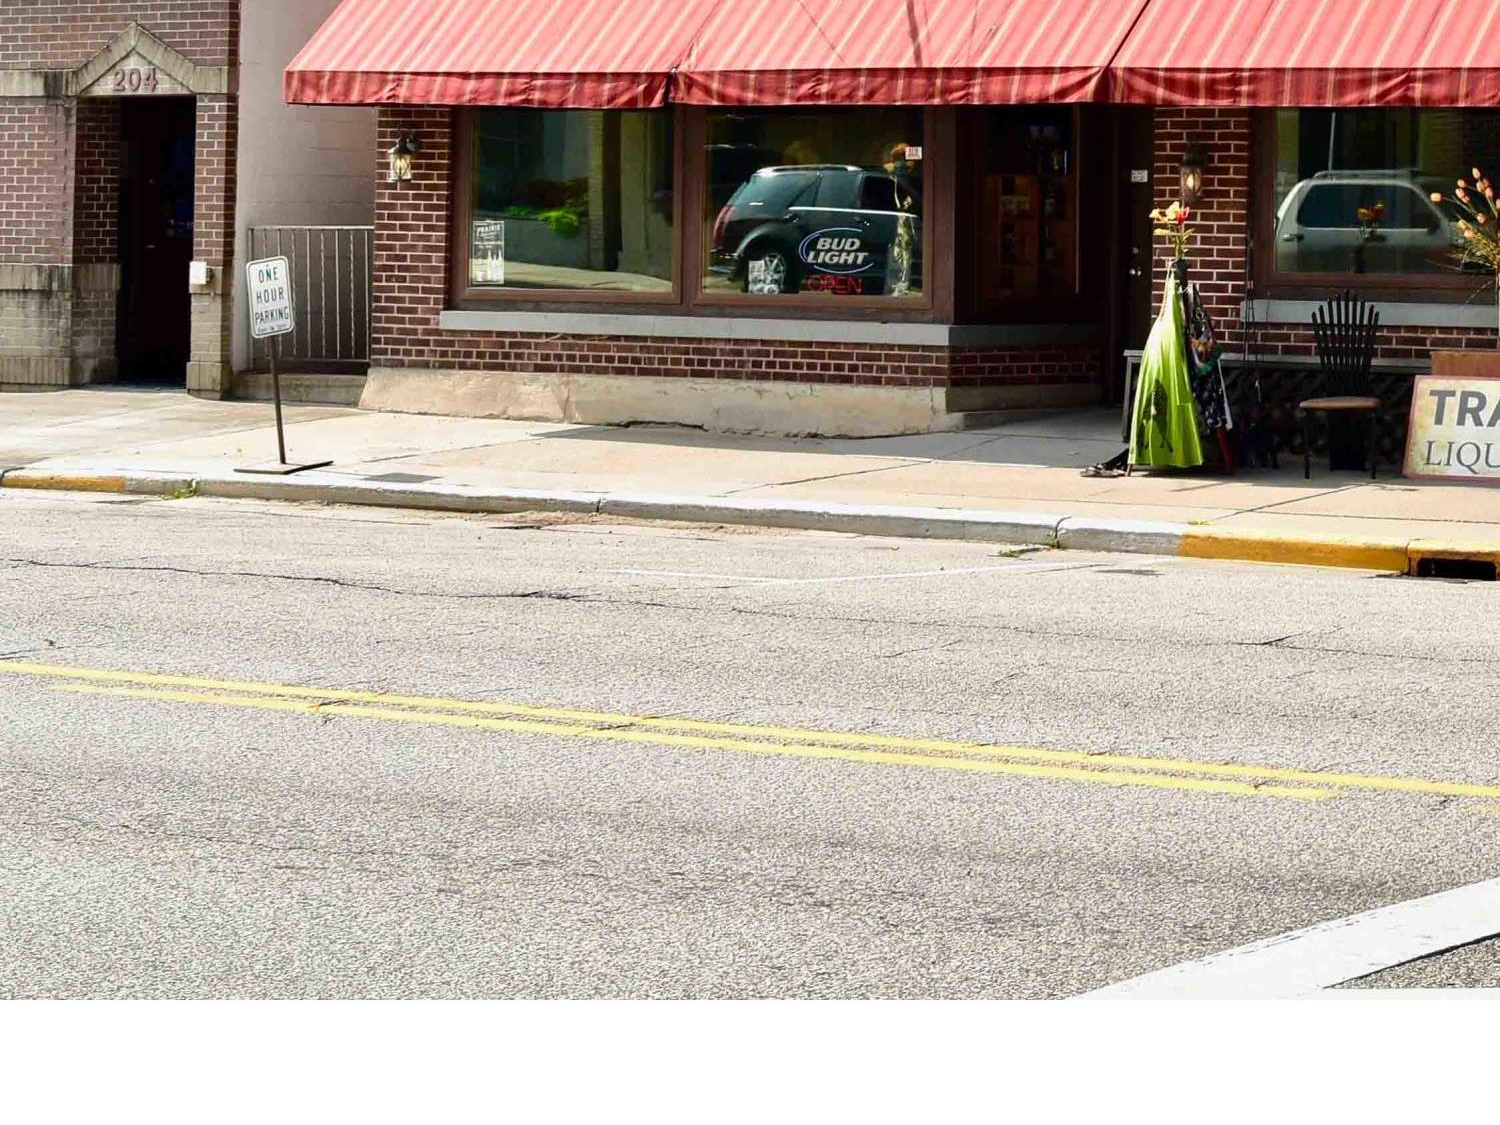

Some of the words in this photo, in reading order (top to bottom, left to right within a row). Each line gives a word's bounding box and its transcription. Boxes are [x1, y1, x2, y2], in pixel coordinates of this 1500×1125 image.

[113, 67, 158, 92] 204
[816, 238, 861, 250] BUD
[807, 251, 869, 264] LIGHT
[258, 266, 278, 283] ONE
[807, 275, 863, 295] OPEN
[256, 287, 285, 304] HOUR
[255, 306, 289, 325] PARKING
